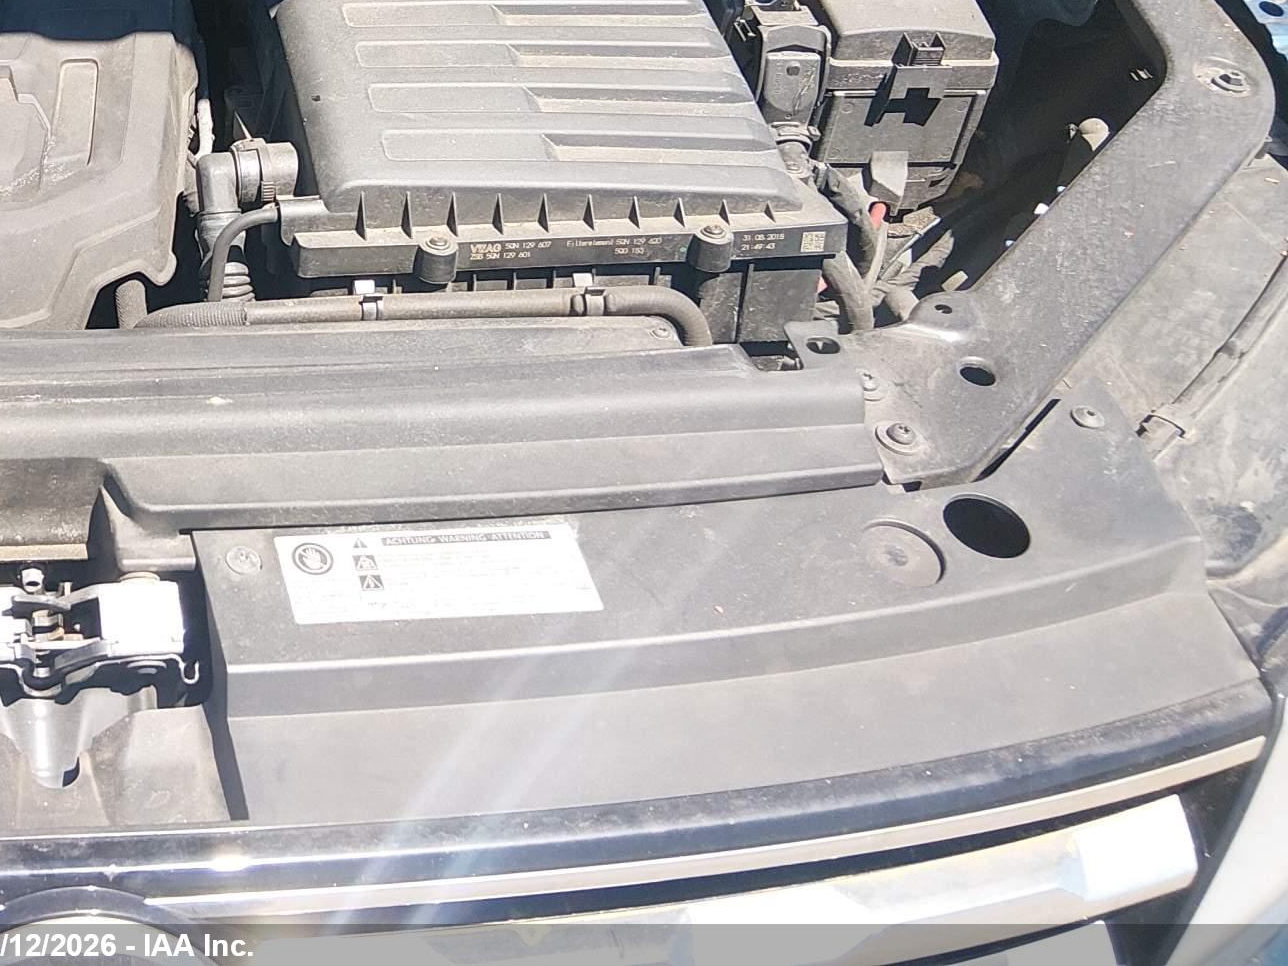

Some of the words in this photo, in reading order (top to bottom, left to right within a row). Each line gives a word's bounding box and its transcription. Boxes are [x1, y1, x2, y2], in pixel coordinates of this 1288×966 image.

[522, 241, 536, 249] 129
[632, 237, 647, 245] 129
[503, 251, 516, 259] 129
[438, 534, 487, 543] WARNING
[491, 530, 544, 540] ATTENTION
